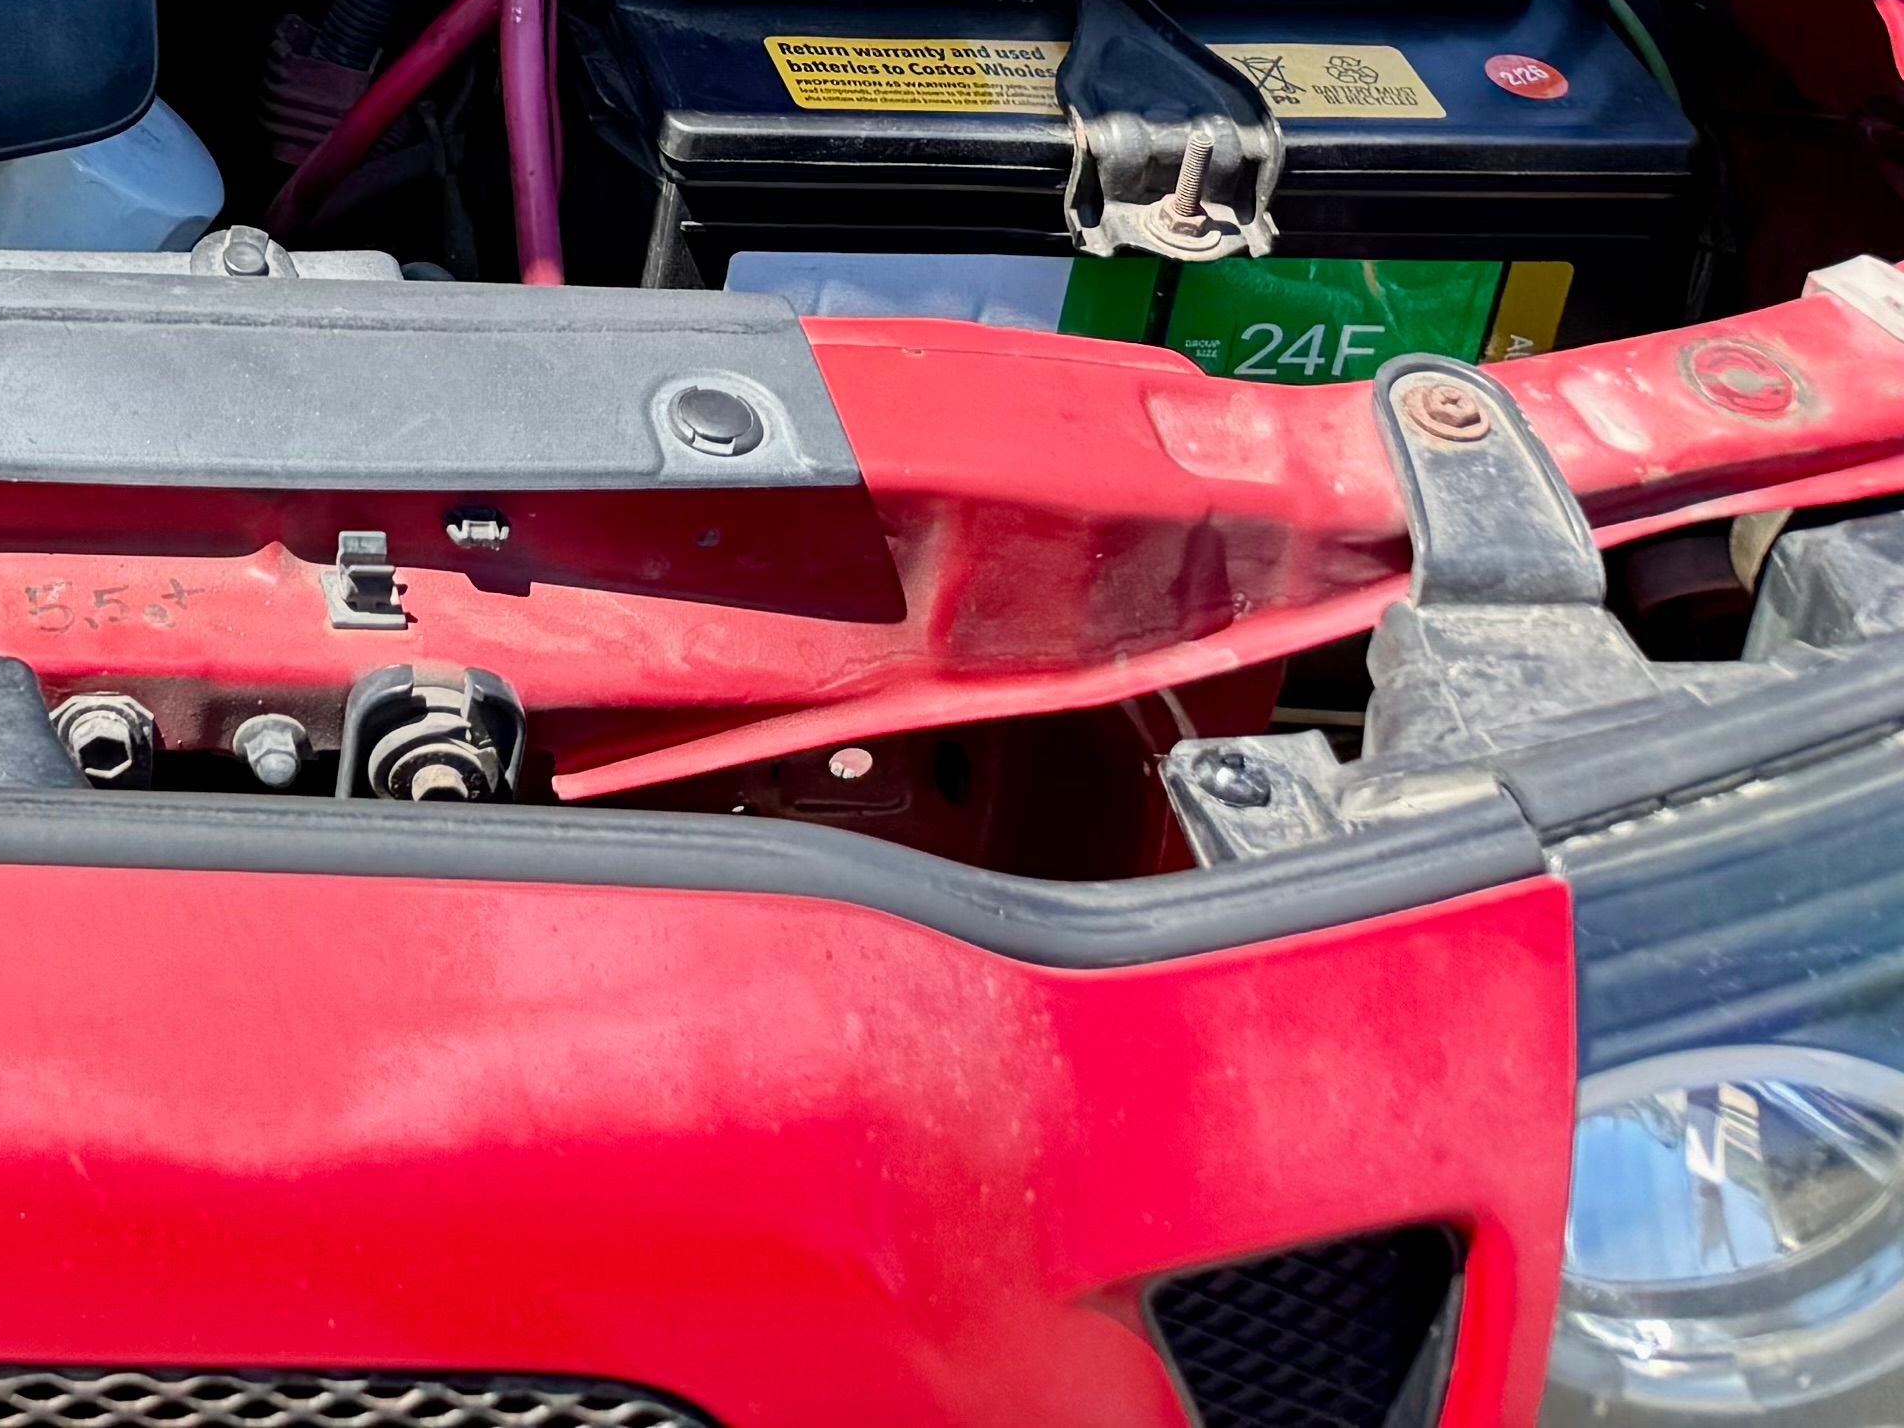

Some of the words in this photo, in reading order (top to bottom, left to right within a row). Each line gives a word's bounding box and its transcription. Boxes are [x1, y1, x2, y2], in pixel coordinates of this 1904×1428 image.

[777, 42, 849, 57] Return
[853, 46, 946, 62] warranty
[951, 45, 989, 59] and
[995, 47, 1046, 61] used
[787, 59, 880, 75] batteries
[885, 63, 906, 76] to
[911, 62, 976, 77] Costco
[981, 63, 1057, 79] Wholes
[1499, 63, 1550, 87] 2/26
[1376, 86, 1417, 97] MUST
[1234, 322, 1387, 377] 24F
